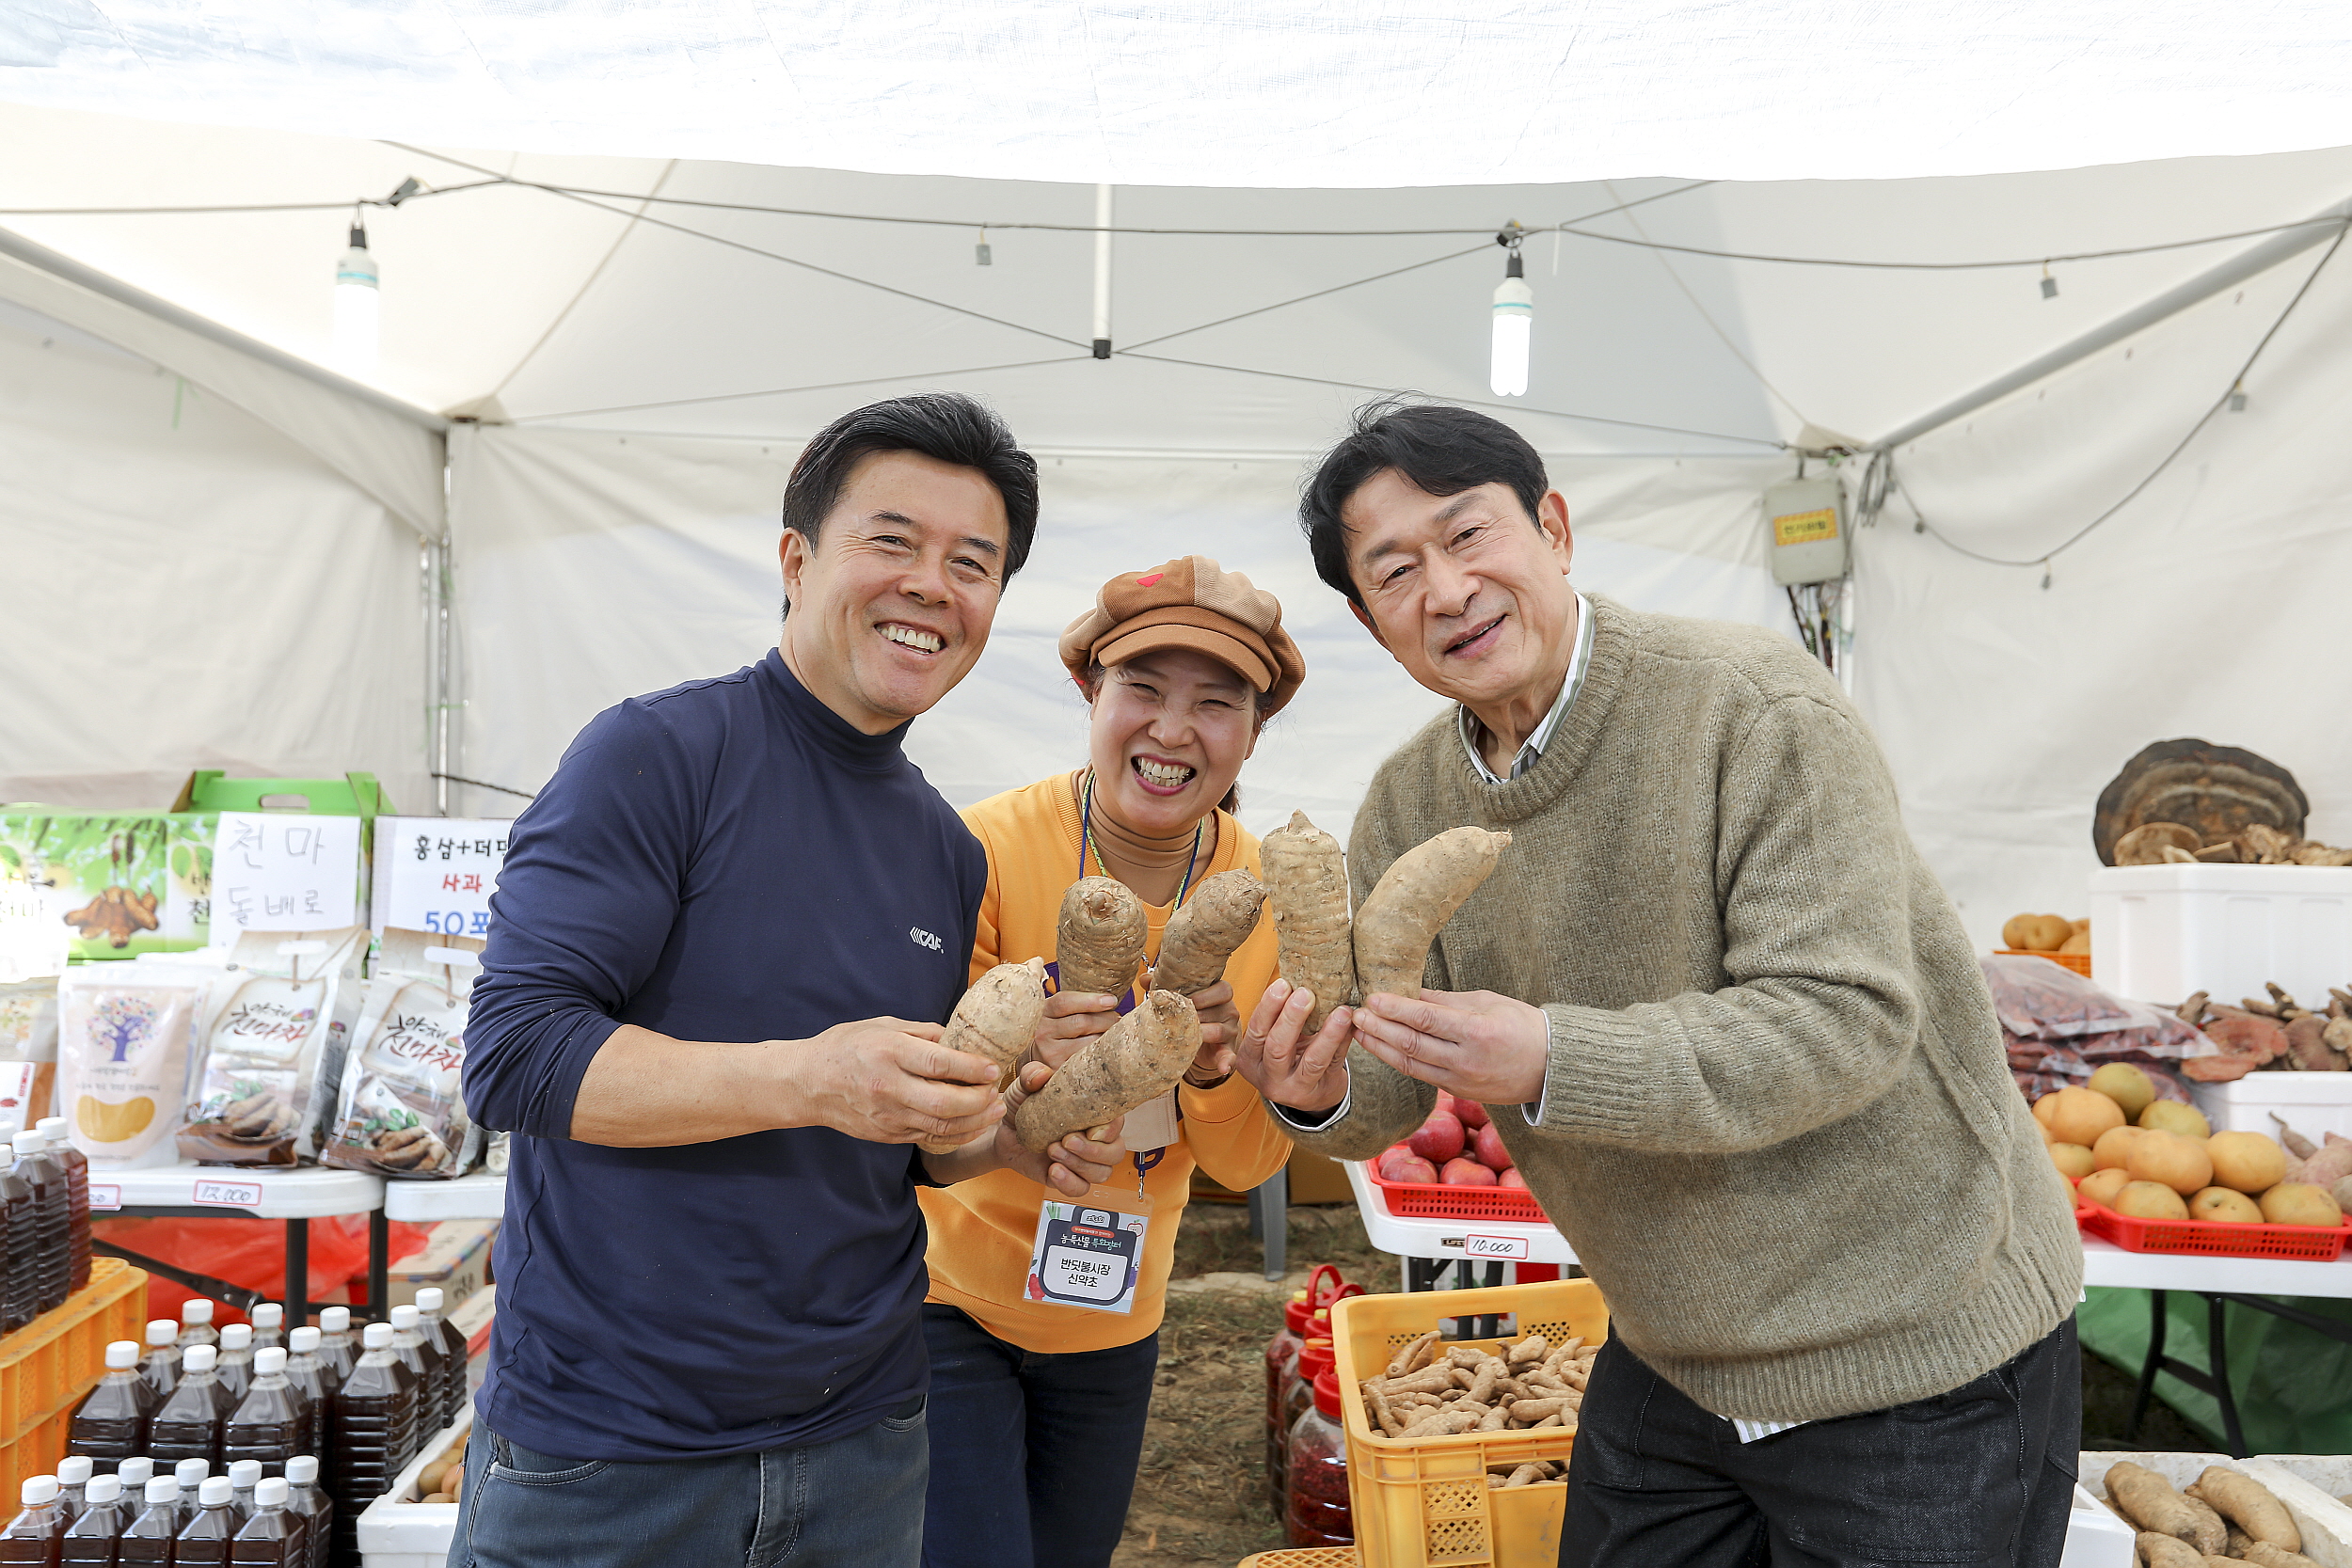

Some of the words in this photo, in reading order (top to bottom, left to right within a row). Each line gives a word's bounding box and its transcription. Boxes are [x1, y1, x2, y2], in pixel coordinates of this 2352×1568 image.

[441, 874, 483, 893] 사과
[1060, 1259, 1111, 1275] 반딧불시장
[1068, 1274, 1098, 1287] 신약초
